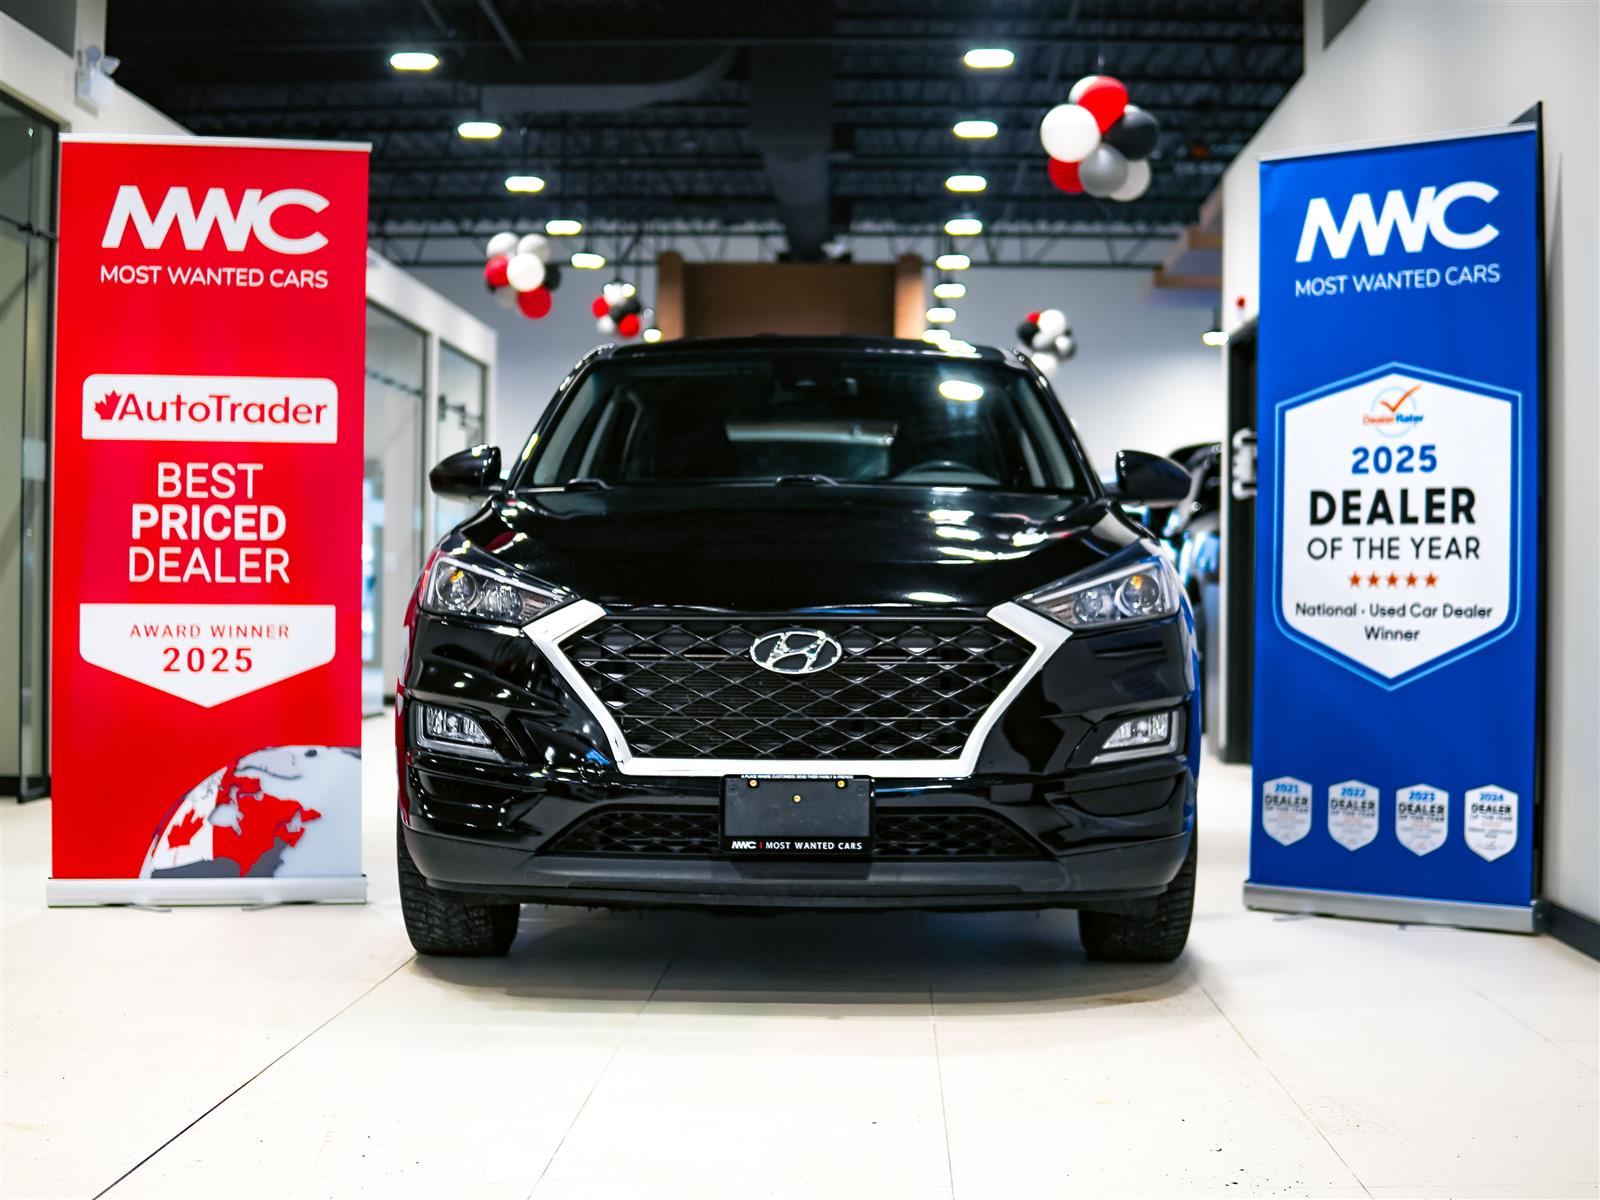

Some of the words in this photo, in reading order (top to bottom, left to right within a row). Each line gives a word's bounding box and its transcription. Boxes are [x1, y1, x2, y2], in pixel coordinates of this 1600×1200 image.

[102, 185, 330, 255] MWC
[1295, 181, 1500, 263] MWC
[100, 265, 162, 285] MOST
[167, 266, 264, 287] WANTED
[269, 269, 328, 289] CARS
[1295, 275, 1347, 297] MOST
[1352, 268, 1440, 292] WANTED
[1444, 263, 1500, 286] CARS
[118, 393, 328, 424] AutoTrader
[1351, 444, 1438, 475] 2025
[157, 462, 264, 499] BEST
[1309, 487, 1476, 526] DEALER
[131, 503, 287, 541] PRICED
[1306, 537, 1343, 561] OF
[1352, 537, 1400, 560] THE
[1410, 536, 1481, 560] YEAR
[128, 546, 290, 584] DEALER
[1295, 602, 1357, 618] National
[1369, 603, 1406, 618] Used
[1409, 602, 1438, 618] Car
[1442, 603, 1493, 619] Dealer
[129, 624, 201, 638] AWARD
[210, 625, 290, 639] WINNER
[1364, 625, 1420, 642] Winner
[162, 647, 253, 673] 2025
[1264, 794, 1309, 807] DEALER
[1330, 798, 1375, 811] DEALER
[1398, 802, 1445, 816] DEALER
[1471, 803, 1512, 816] DEALER
[731, 840, 757, 850] MWC
[765, 841, 791, 850] MOST
[794, 841, 835, 851] WANTED
[838, 841, 863, 850] CARS
